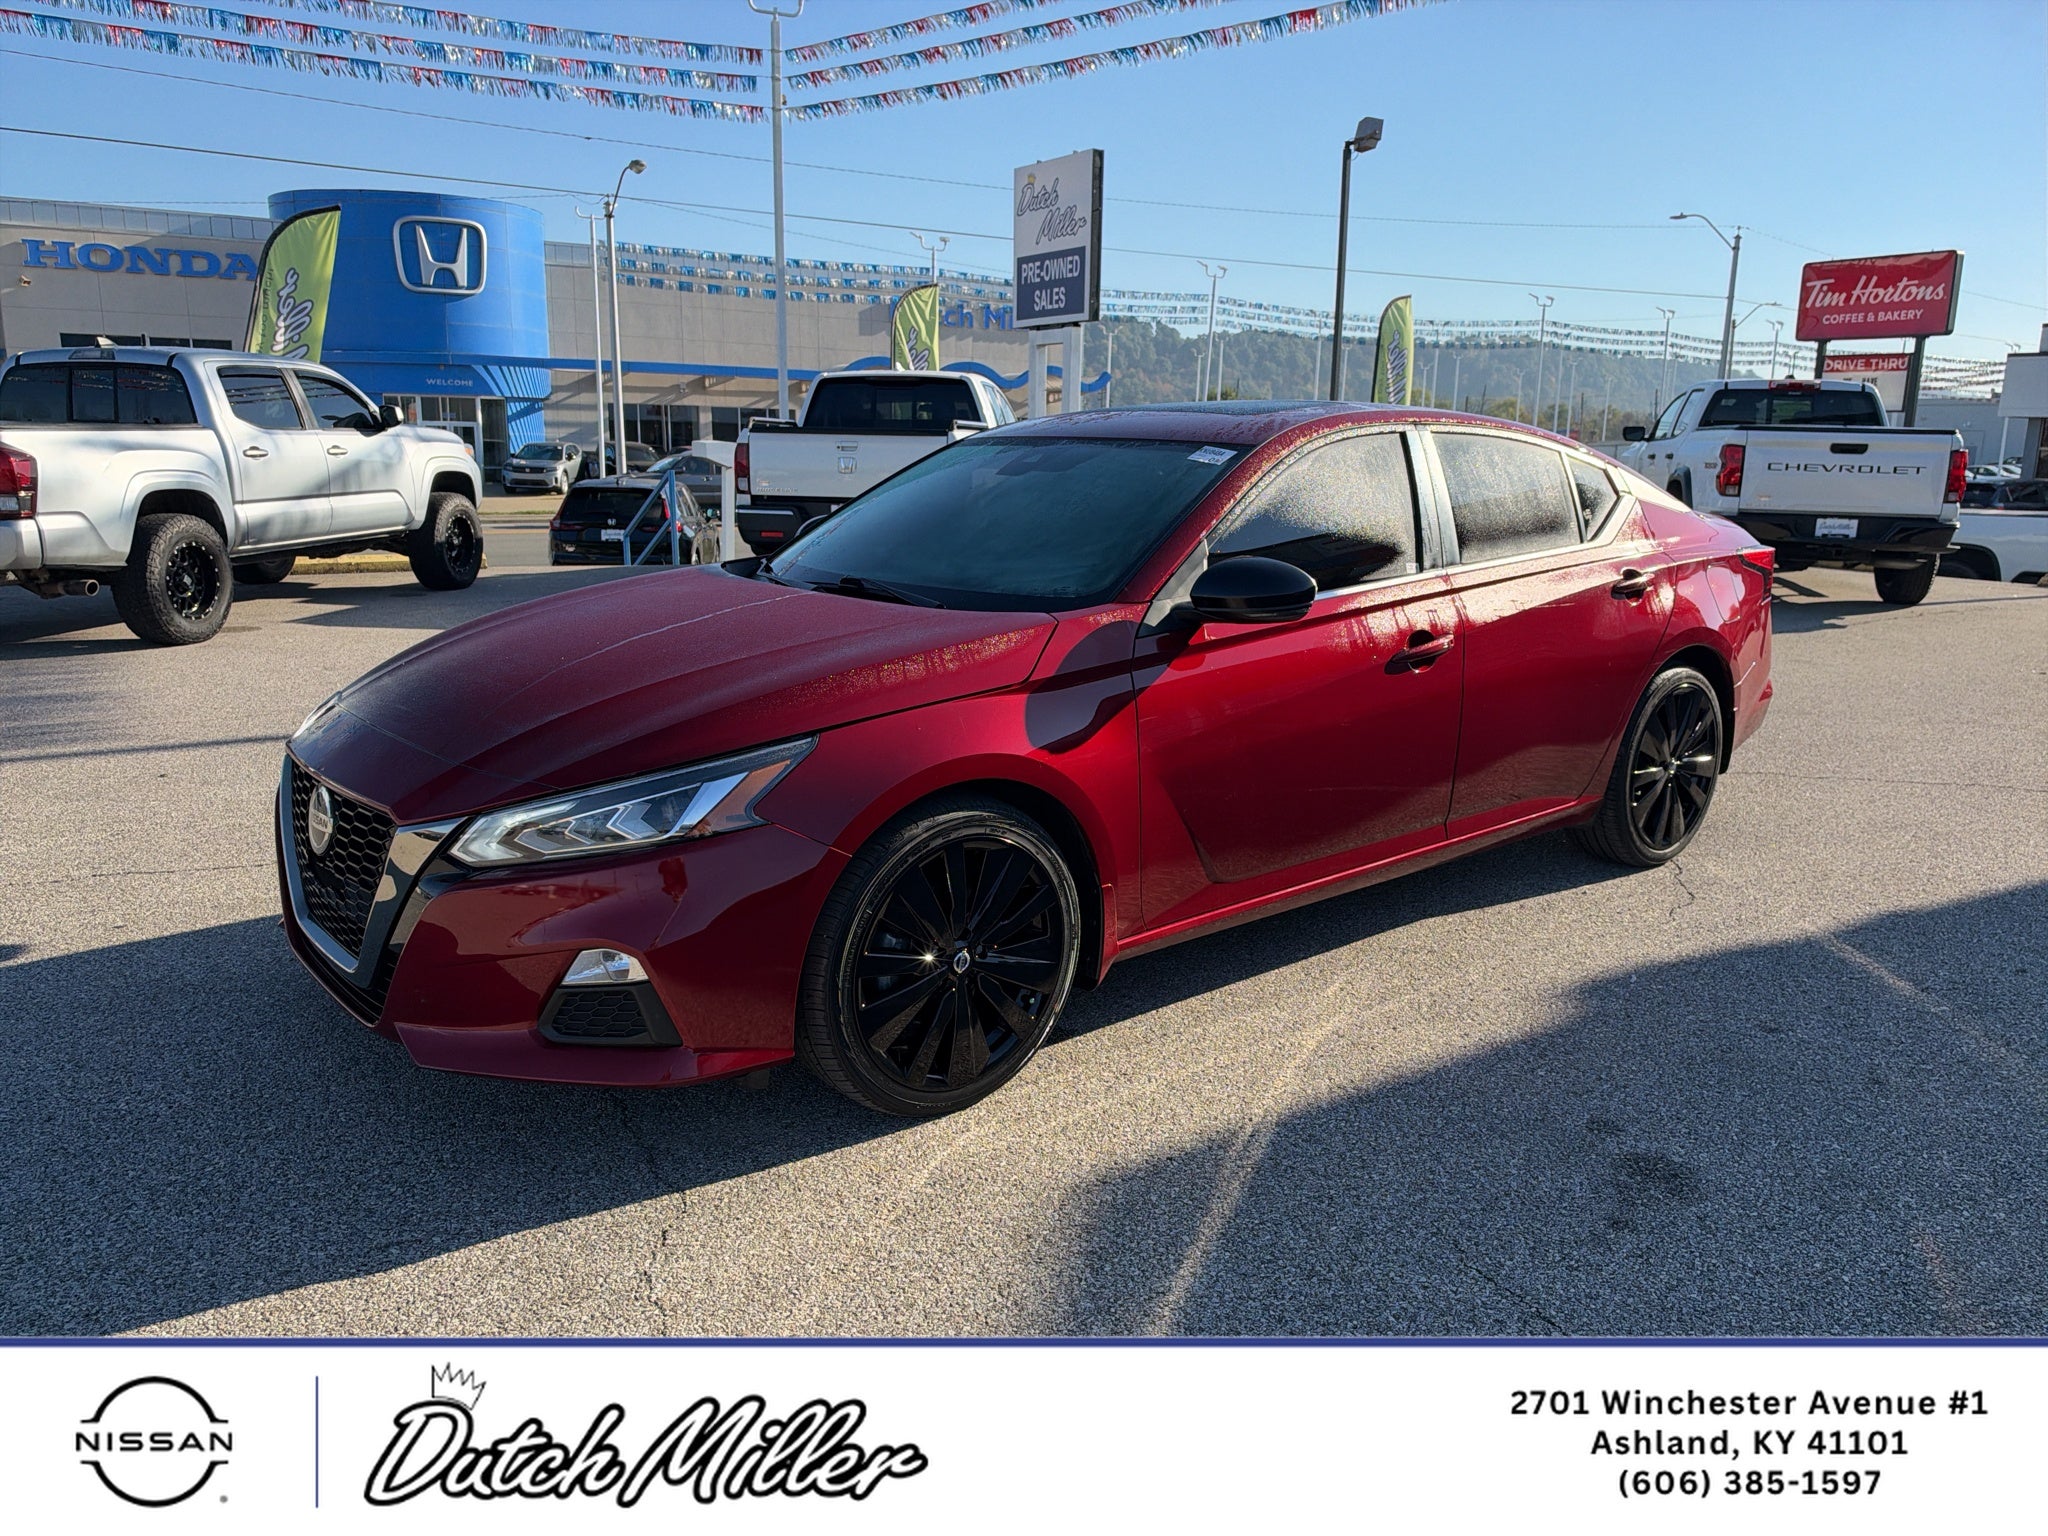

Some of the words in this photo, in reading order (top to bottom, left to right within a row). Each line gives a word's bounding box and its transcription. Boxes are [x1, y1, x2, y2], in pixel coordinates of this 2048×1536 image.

[1017, 177, 1059, 216] Dutch
[1036, 205, 1087, 245] Miller
[21, 238, 258, 281] HONDA
[1021, 255, 1080, 285] PRE-OWNED
[1033, 287, 1066, 312] SALES
[1806, 279, 1848, 308] Tim
[1850, 275, 1946, 305] Hortons
[1822, 312, 1865, 325] COFFEE
[1867, 312, 1875, 322] &
[1877, 309, 1923, 322] BAKERY
[1823, 360, 1866, 371] DRIVE
[1869, 356, 1909, 370] THRU
[426, 378, 474, 387] WELCOME
[1767, 462, 1927, 475] CHEVROLET
